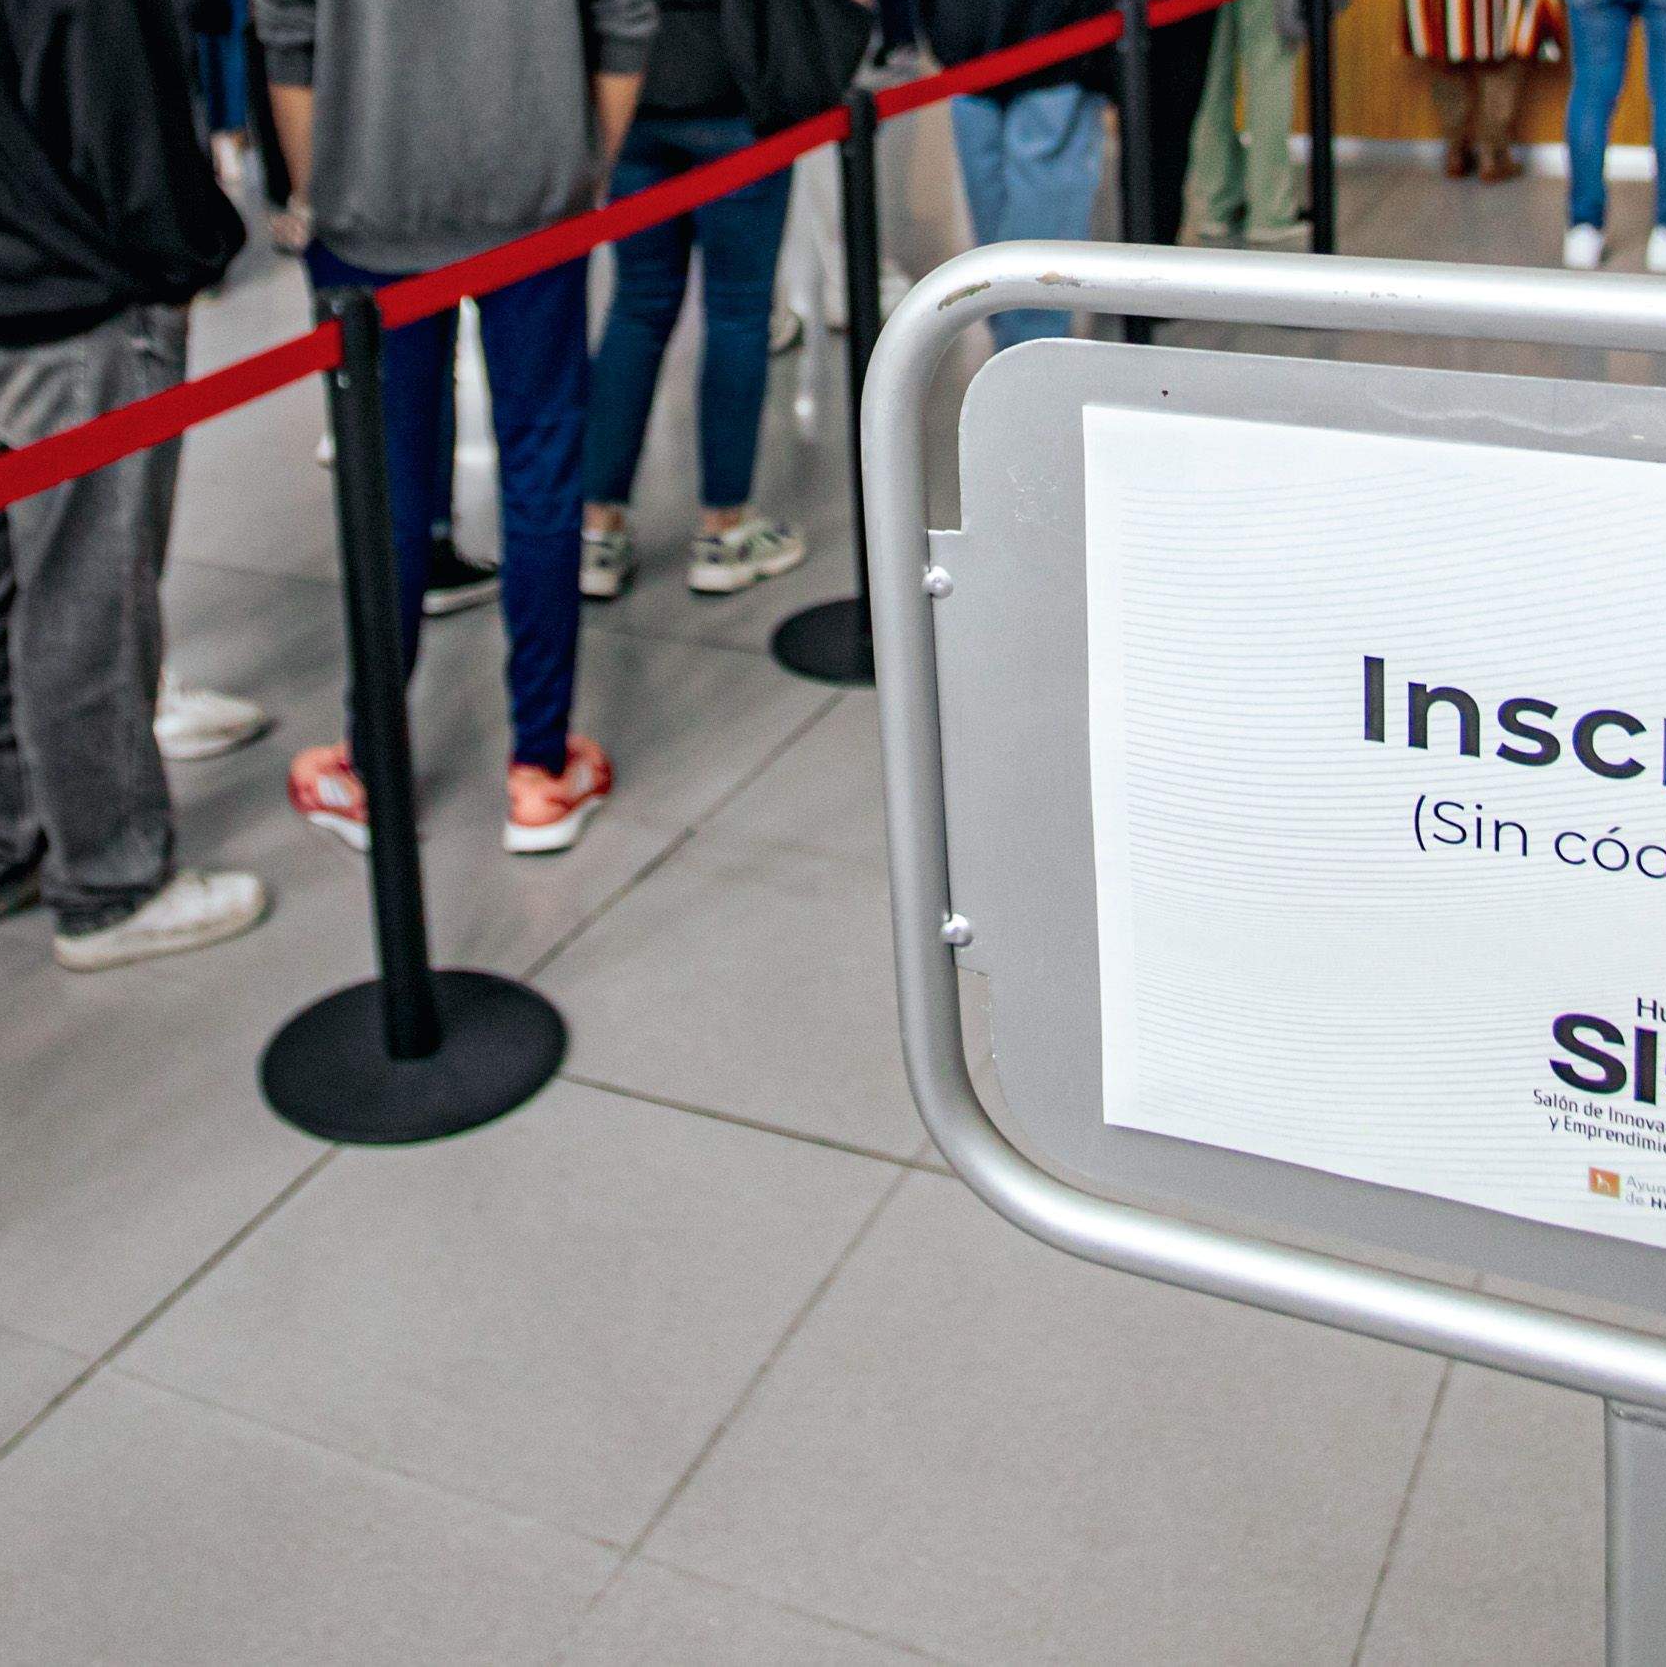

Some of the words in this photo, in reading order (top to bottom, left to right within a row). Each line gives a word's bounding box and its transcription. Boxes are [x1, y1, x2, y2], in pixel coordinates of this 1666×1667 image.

[1414, 794, 1529, 858] (Sin
[1533, 1088, 1579, 1114] Salón
[1583, 1101, 1604, 1120] de
[1548, 1115, 1559, 1132] y
[1625, 1192, 1645, 1207] de
